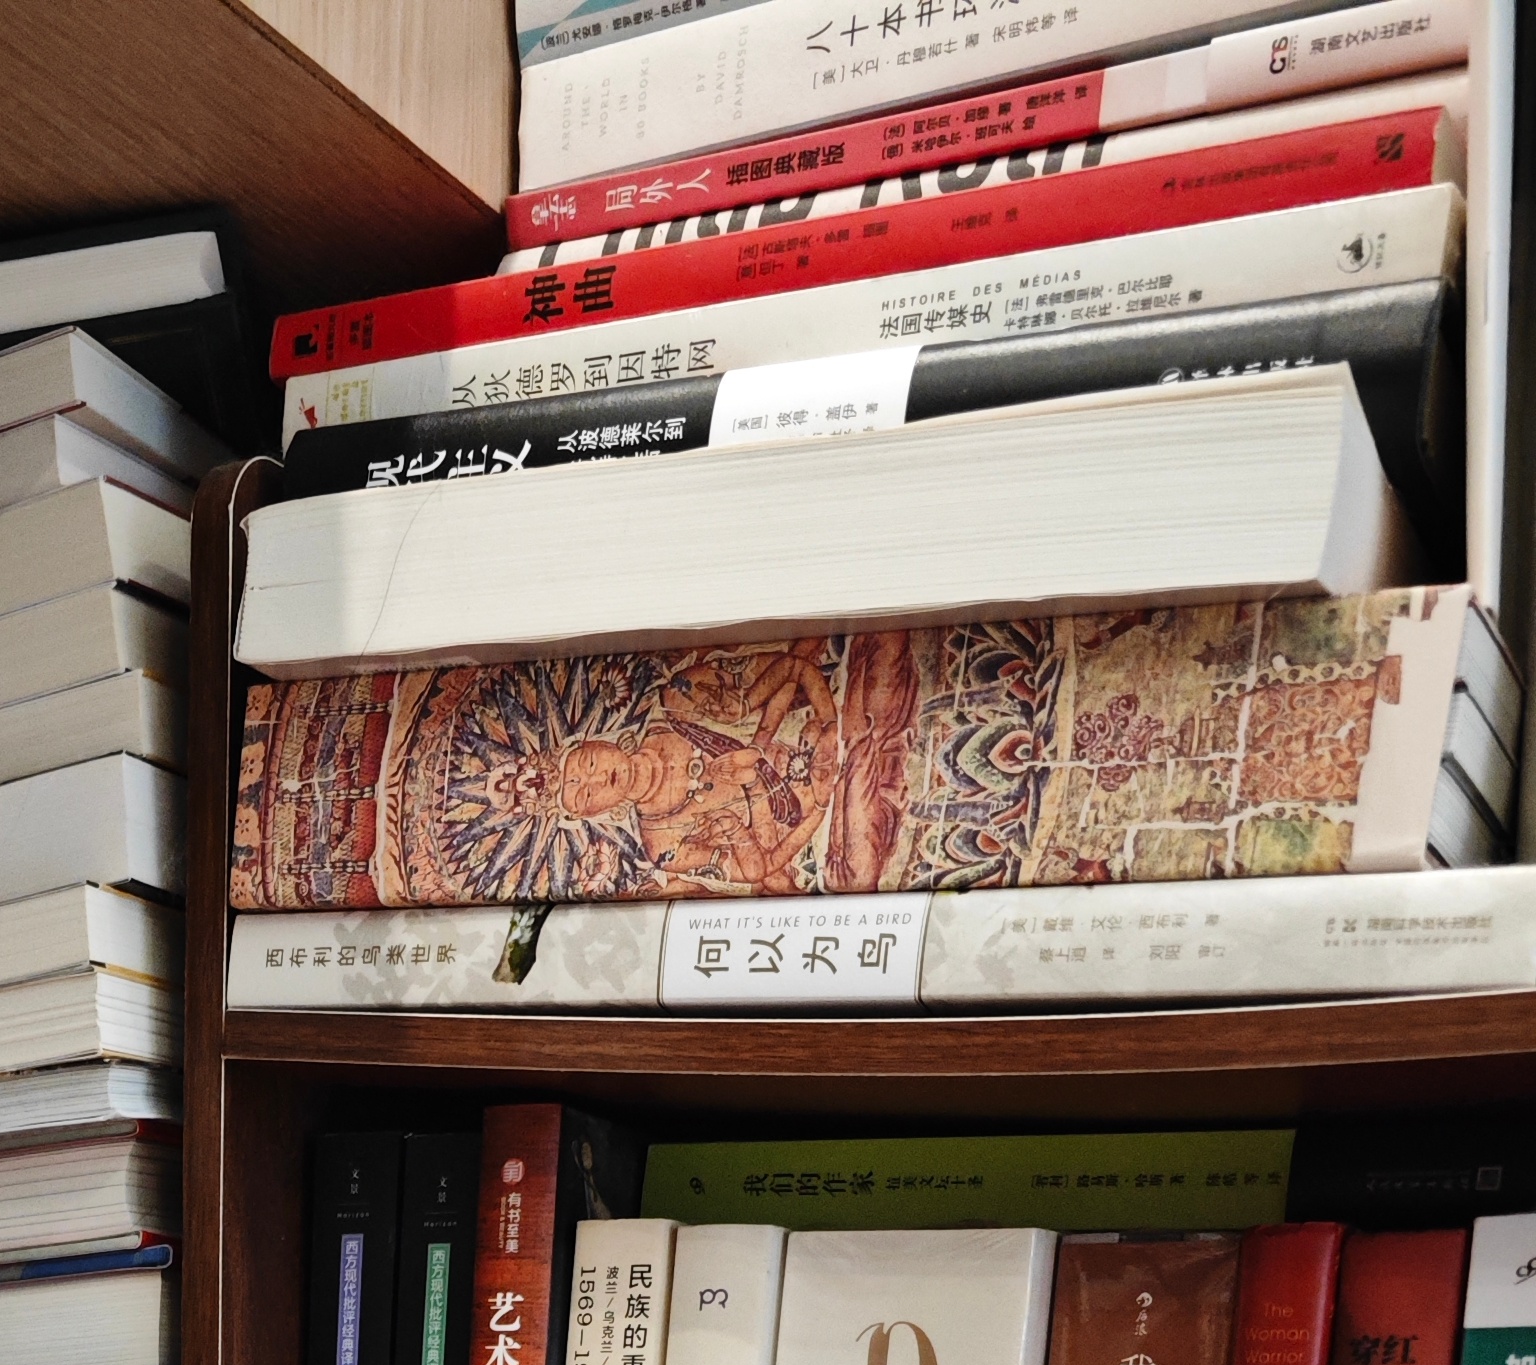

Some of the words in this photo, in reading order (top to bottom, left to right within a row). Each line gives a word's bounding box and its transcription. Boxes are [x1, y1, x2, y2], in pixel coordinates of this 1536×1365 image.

[1310, 15, 1431, 56] 湖南文艺出版社
[605, 168, 712, 213] 局外人
[726, 142, 846, 188] 插图典藏版
[524, 265, 619, 325] 神曲
[881, 289, 958, 311] HISTOIRE
[973, 283, 1004, 296] DES
[1020, 269, 1082, 290] MÉDIAS
[879, 301, 993, 341] 法国传媒史
[451, 339, 717, 408] 从狄德罗到因特网
[558, 417, 687, 453] 从波德莱尔到
[689, 917, 731, 930] WHAT
[737, 917, 763, 929] IT'S
[770, 916, 801, 928] LIKE
[809, 915, 826, 927] TO
[834, 914, 851, 926] BE
[875, 912, 912, 925] BIRD
[264, 937, 459, 969] 西布利的鸟类世界
[694, 933, 897, 978] 何以为鸟
[742, 1170, 876, 1199] 我们的作家
[505, 1193, 522, 1255] 有书至美
